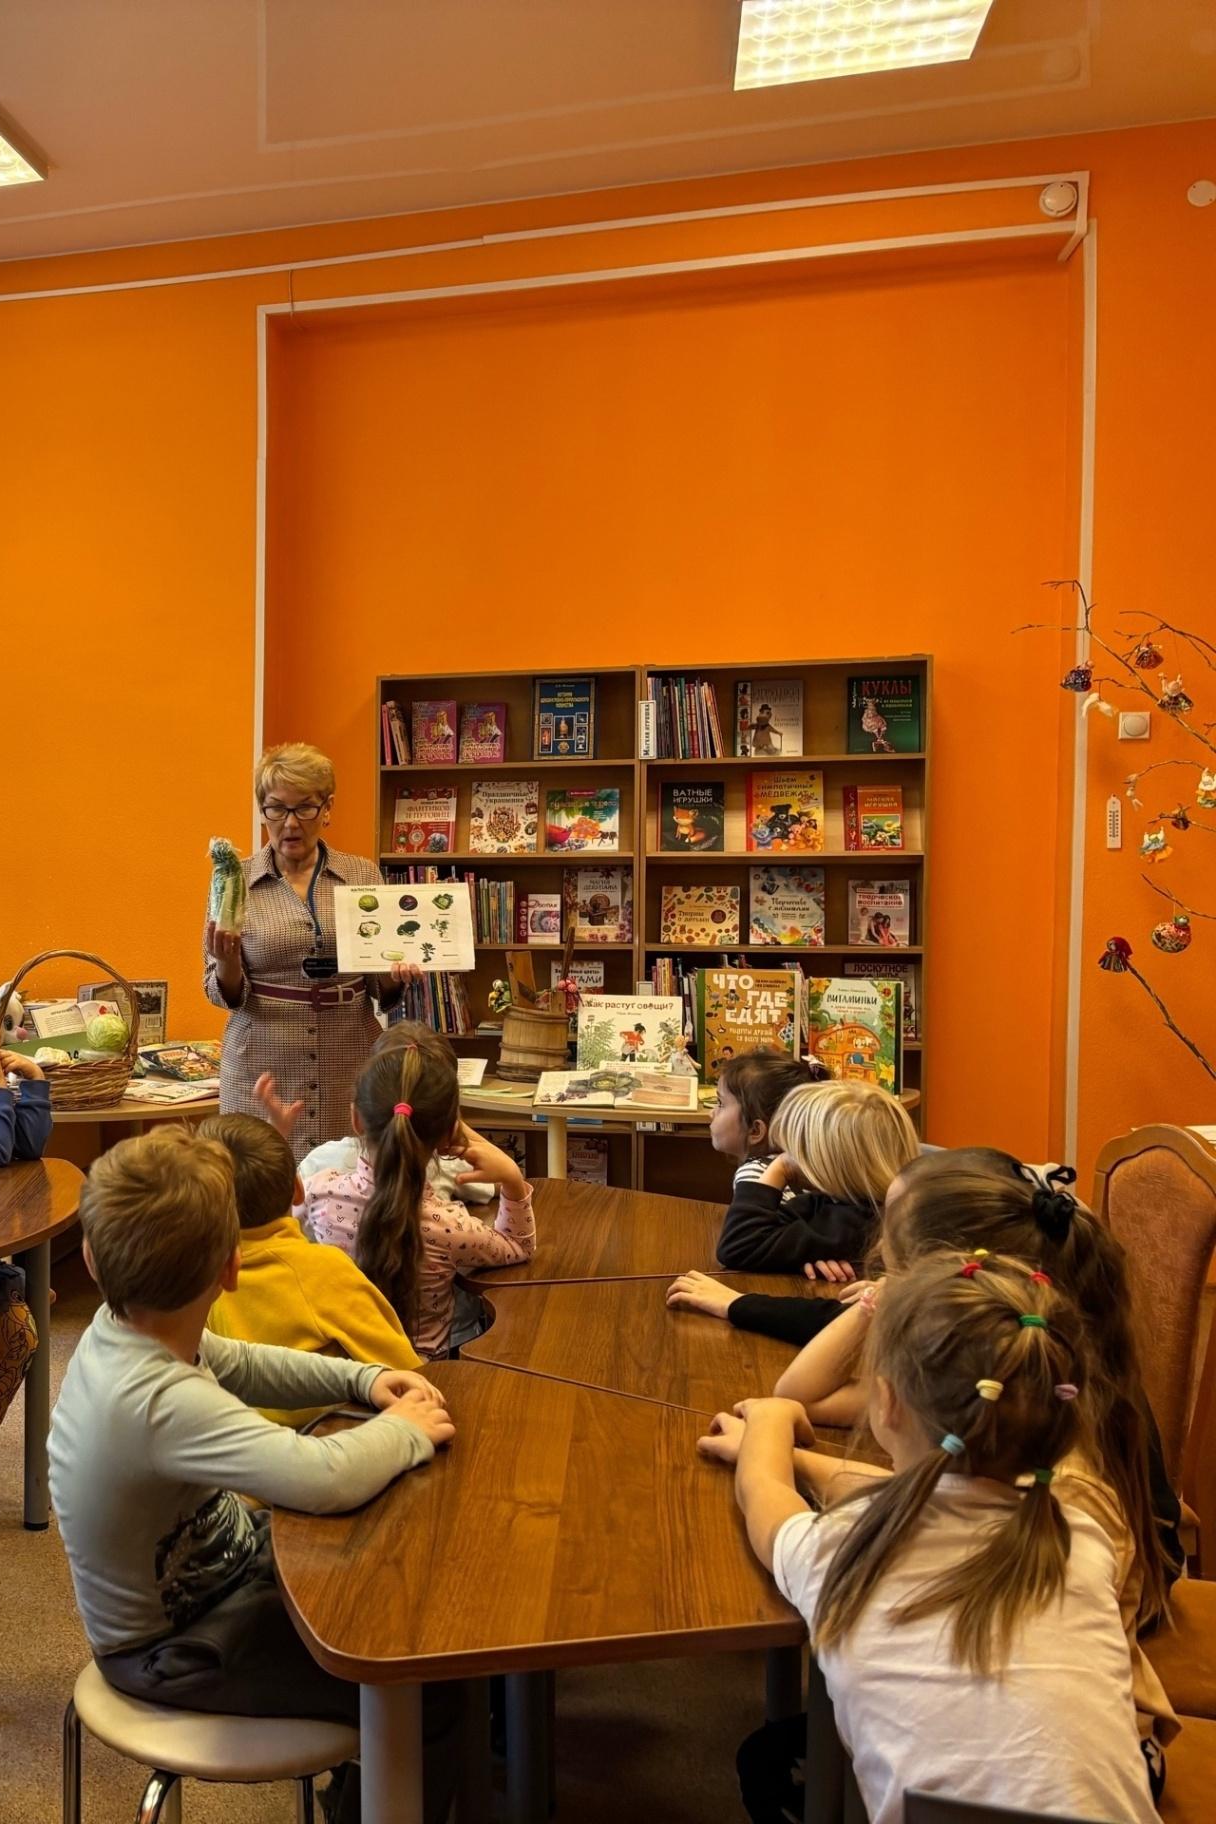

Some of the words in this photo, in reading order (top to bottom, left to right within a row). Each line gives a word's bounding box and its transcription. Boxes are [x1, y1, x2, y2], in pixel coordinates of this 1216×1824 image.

[861, 680, 912, 695] КУКЛЫ
[672, 788, 713, 797] ВАТНЫЕ
[672, 796, 713, 804] ИГРУШКИ
[853, 963, 909, 973] ЛОСКУТНОЕ
[712, 973, 754, 990] ЧТО
[746, 990, 788, 1010] ГДЕ
[826, 993, 878, 1006] ВИТАМИНКИ
[604, 1001, 635, 1010] растут
[636, 1001, 675, 1012] овощи?
[725, 1007, 782, 1026] ЕДЯТ
